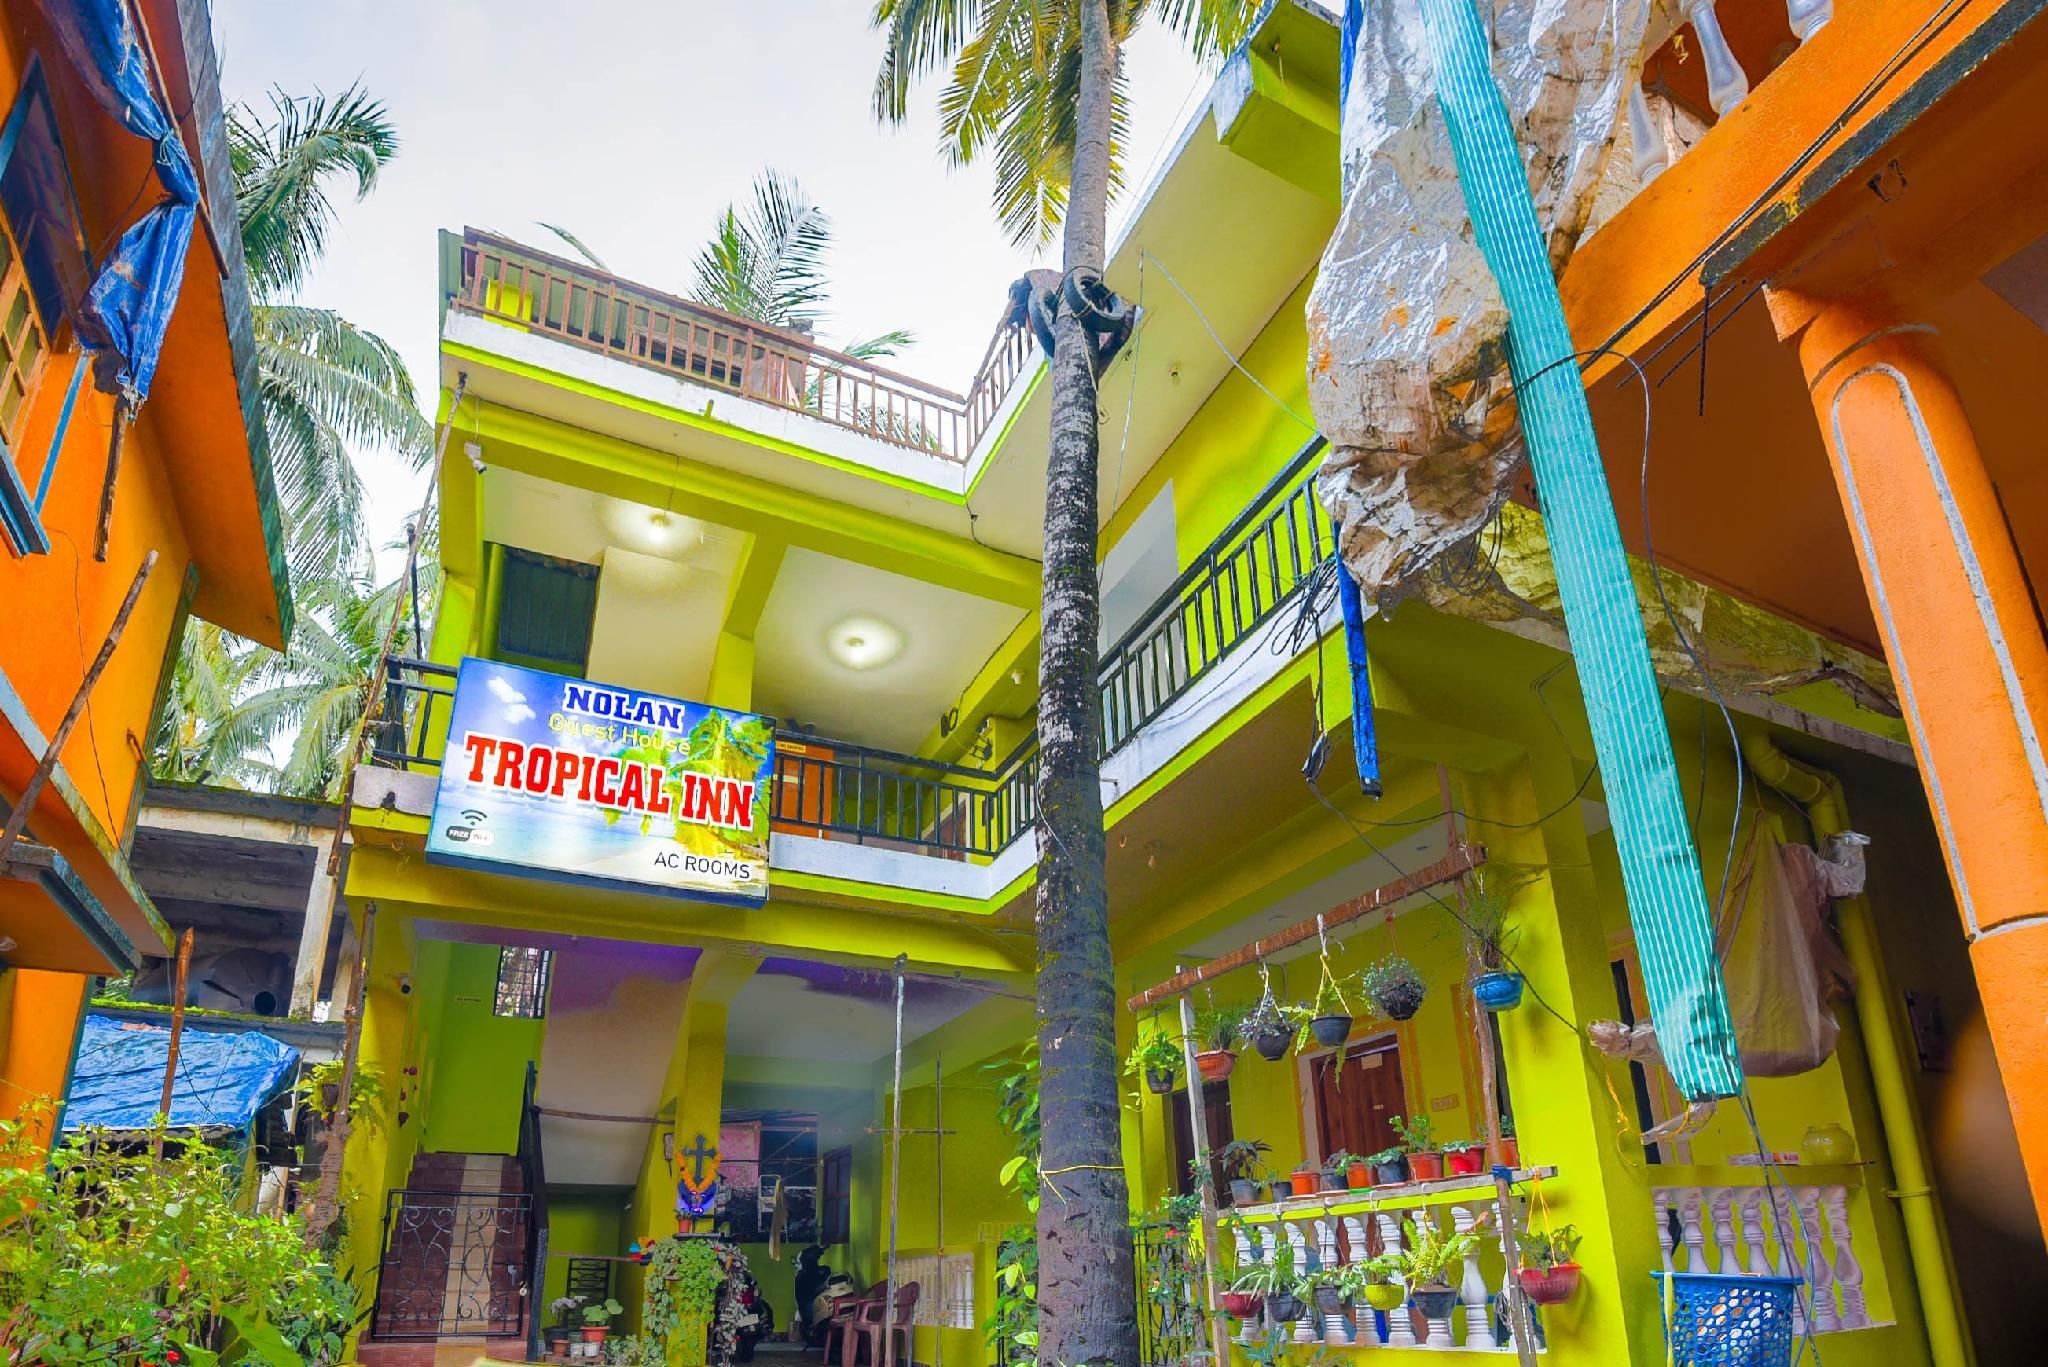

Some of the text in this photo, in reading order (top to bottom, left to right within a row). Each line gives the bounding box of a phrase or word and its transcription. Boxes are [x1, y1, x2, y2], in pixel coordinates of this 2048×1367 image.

[565, 685, 683, 731] NOLAN
[548, 712, 691, 756] Guest House
[465, 735, 754, 829] TROPICAL INN
[654, 851, 750, 879] AC ROOMS
